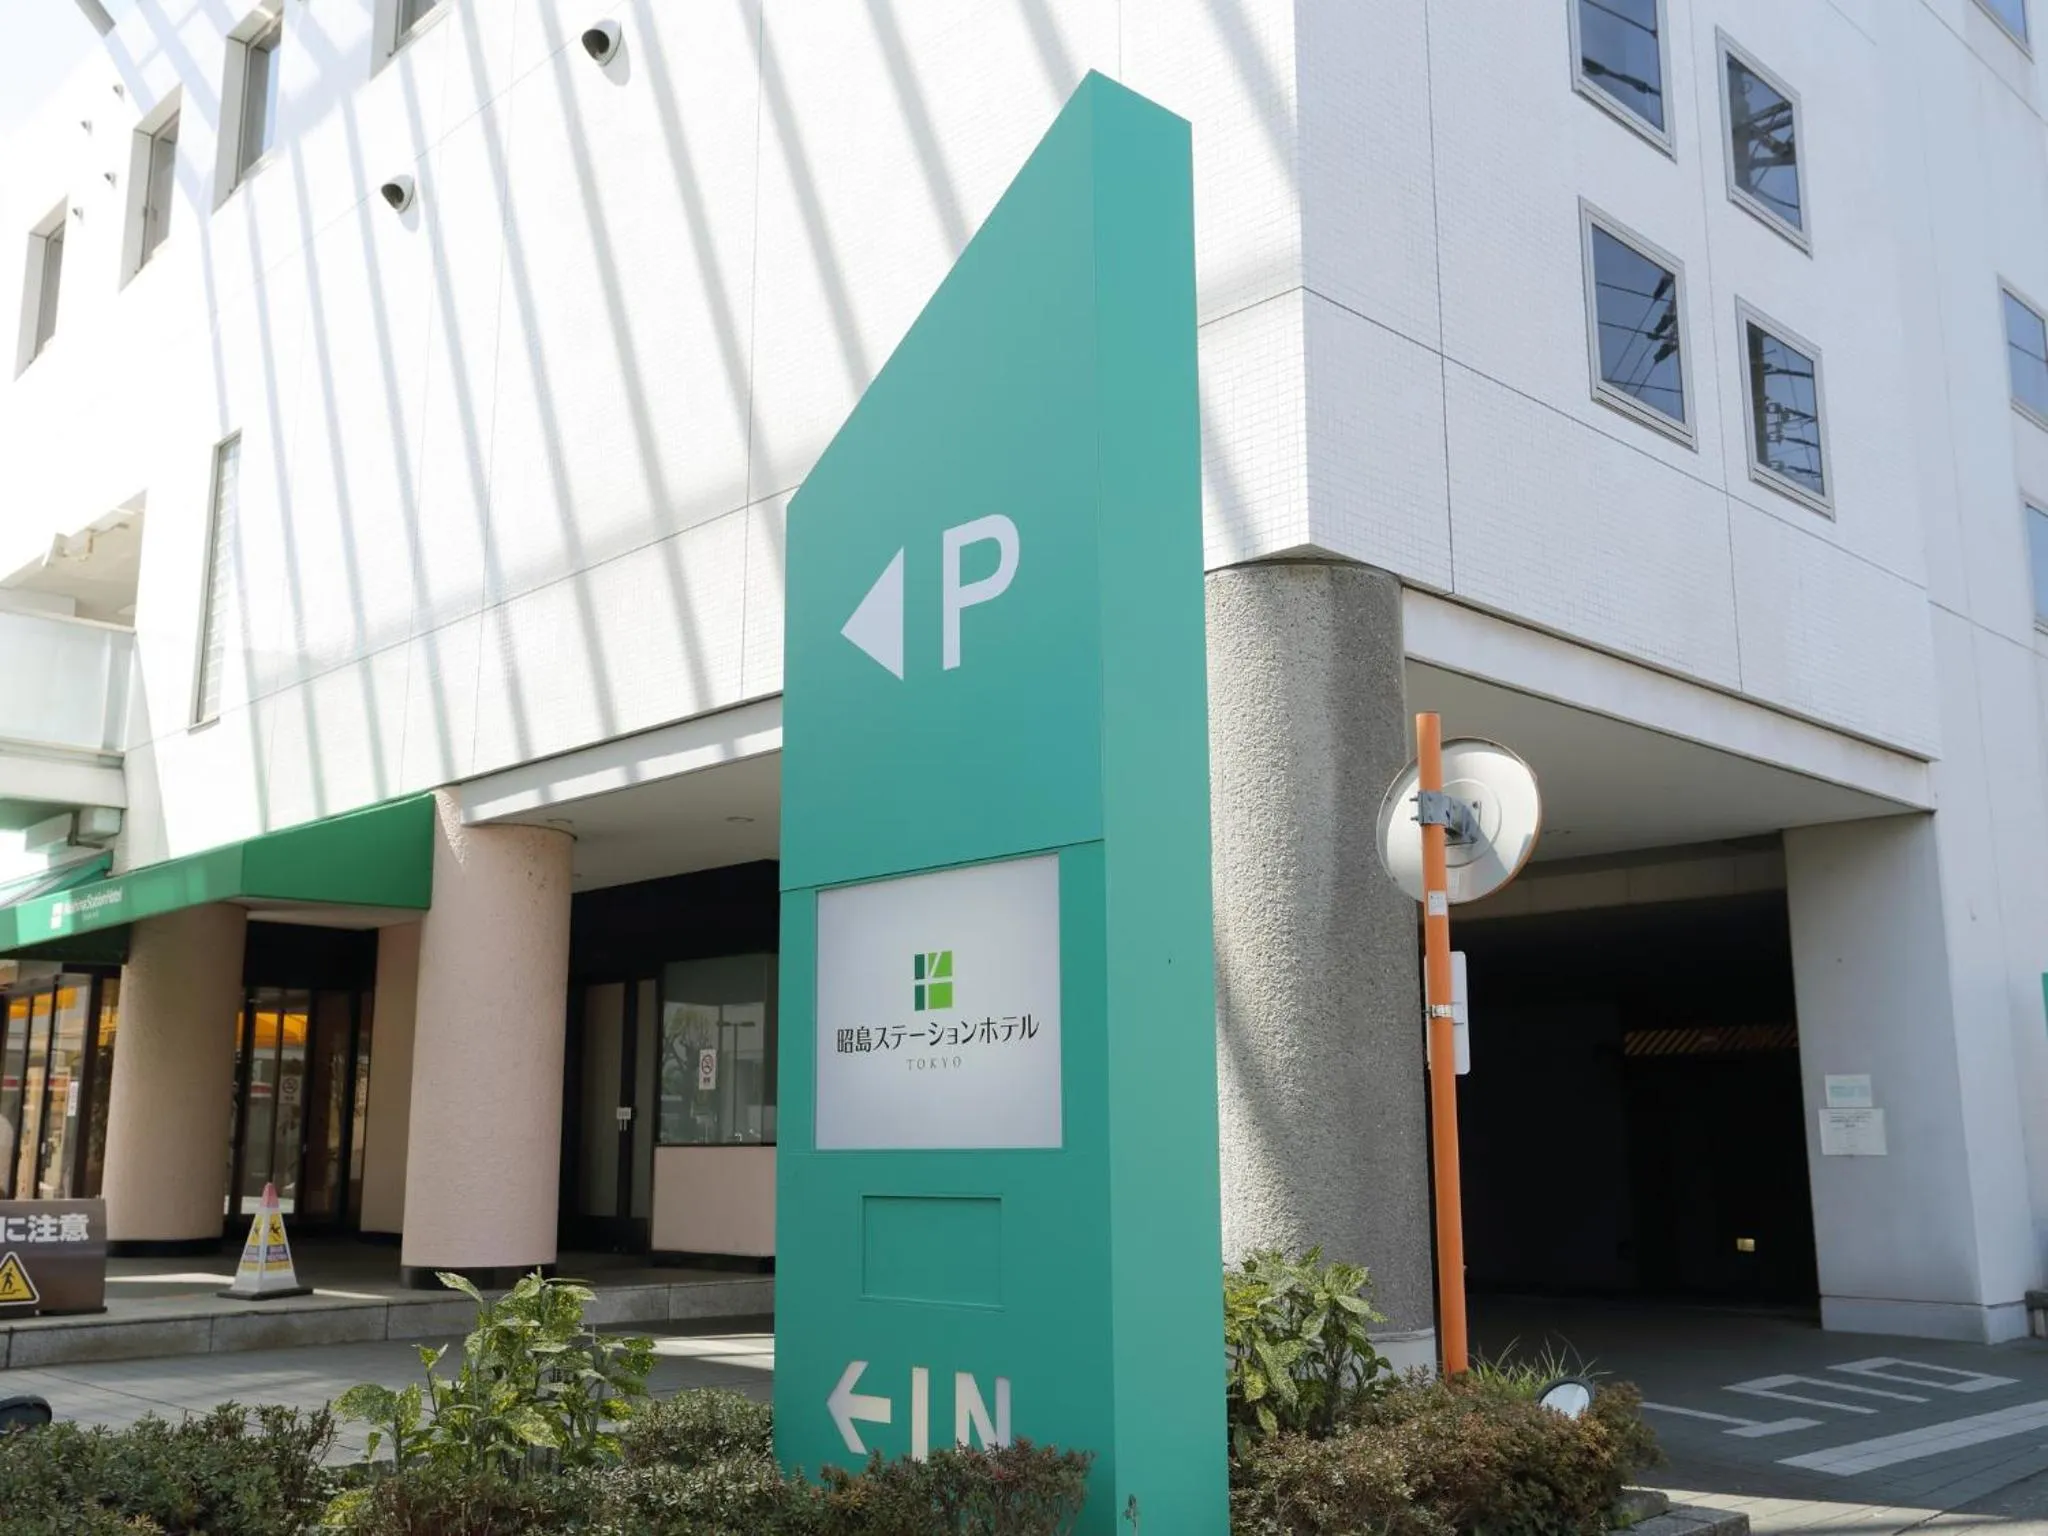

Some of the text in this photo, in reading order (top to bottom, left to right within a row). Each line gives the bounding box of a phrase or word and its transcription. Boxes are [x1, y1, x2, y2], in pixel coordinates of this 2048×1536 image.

[943, 514, 1020, 671] P
[837, 1013, 1040, 1054] 昭島ステーションホテル
[906, 1056, 963, 1072] TOKYO
[0, 1213, 90, 1243] に注意
[911, 1366, 1011, 1464] IN
